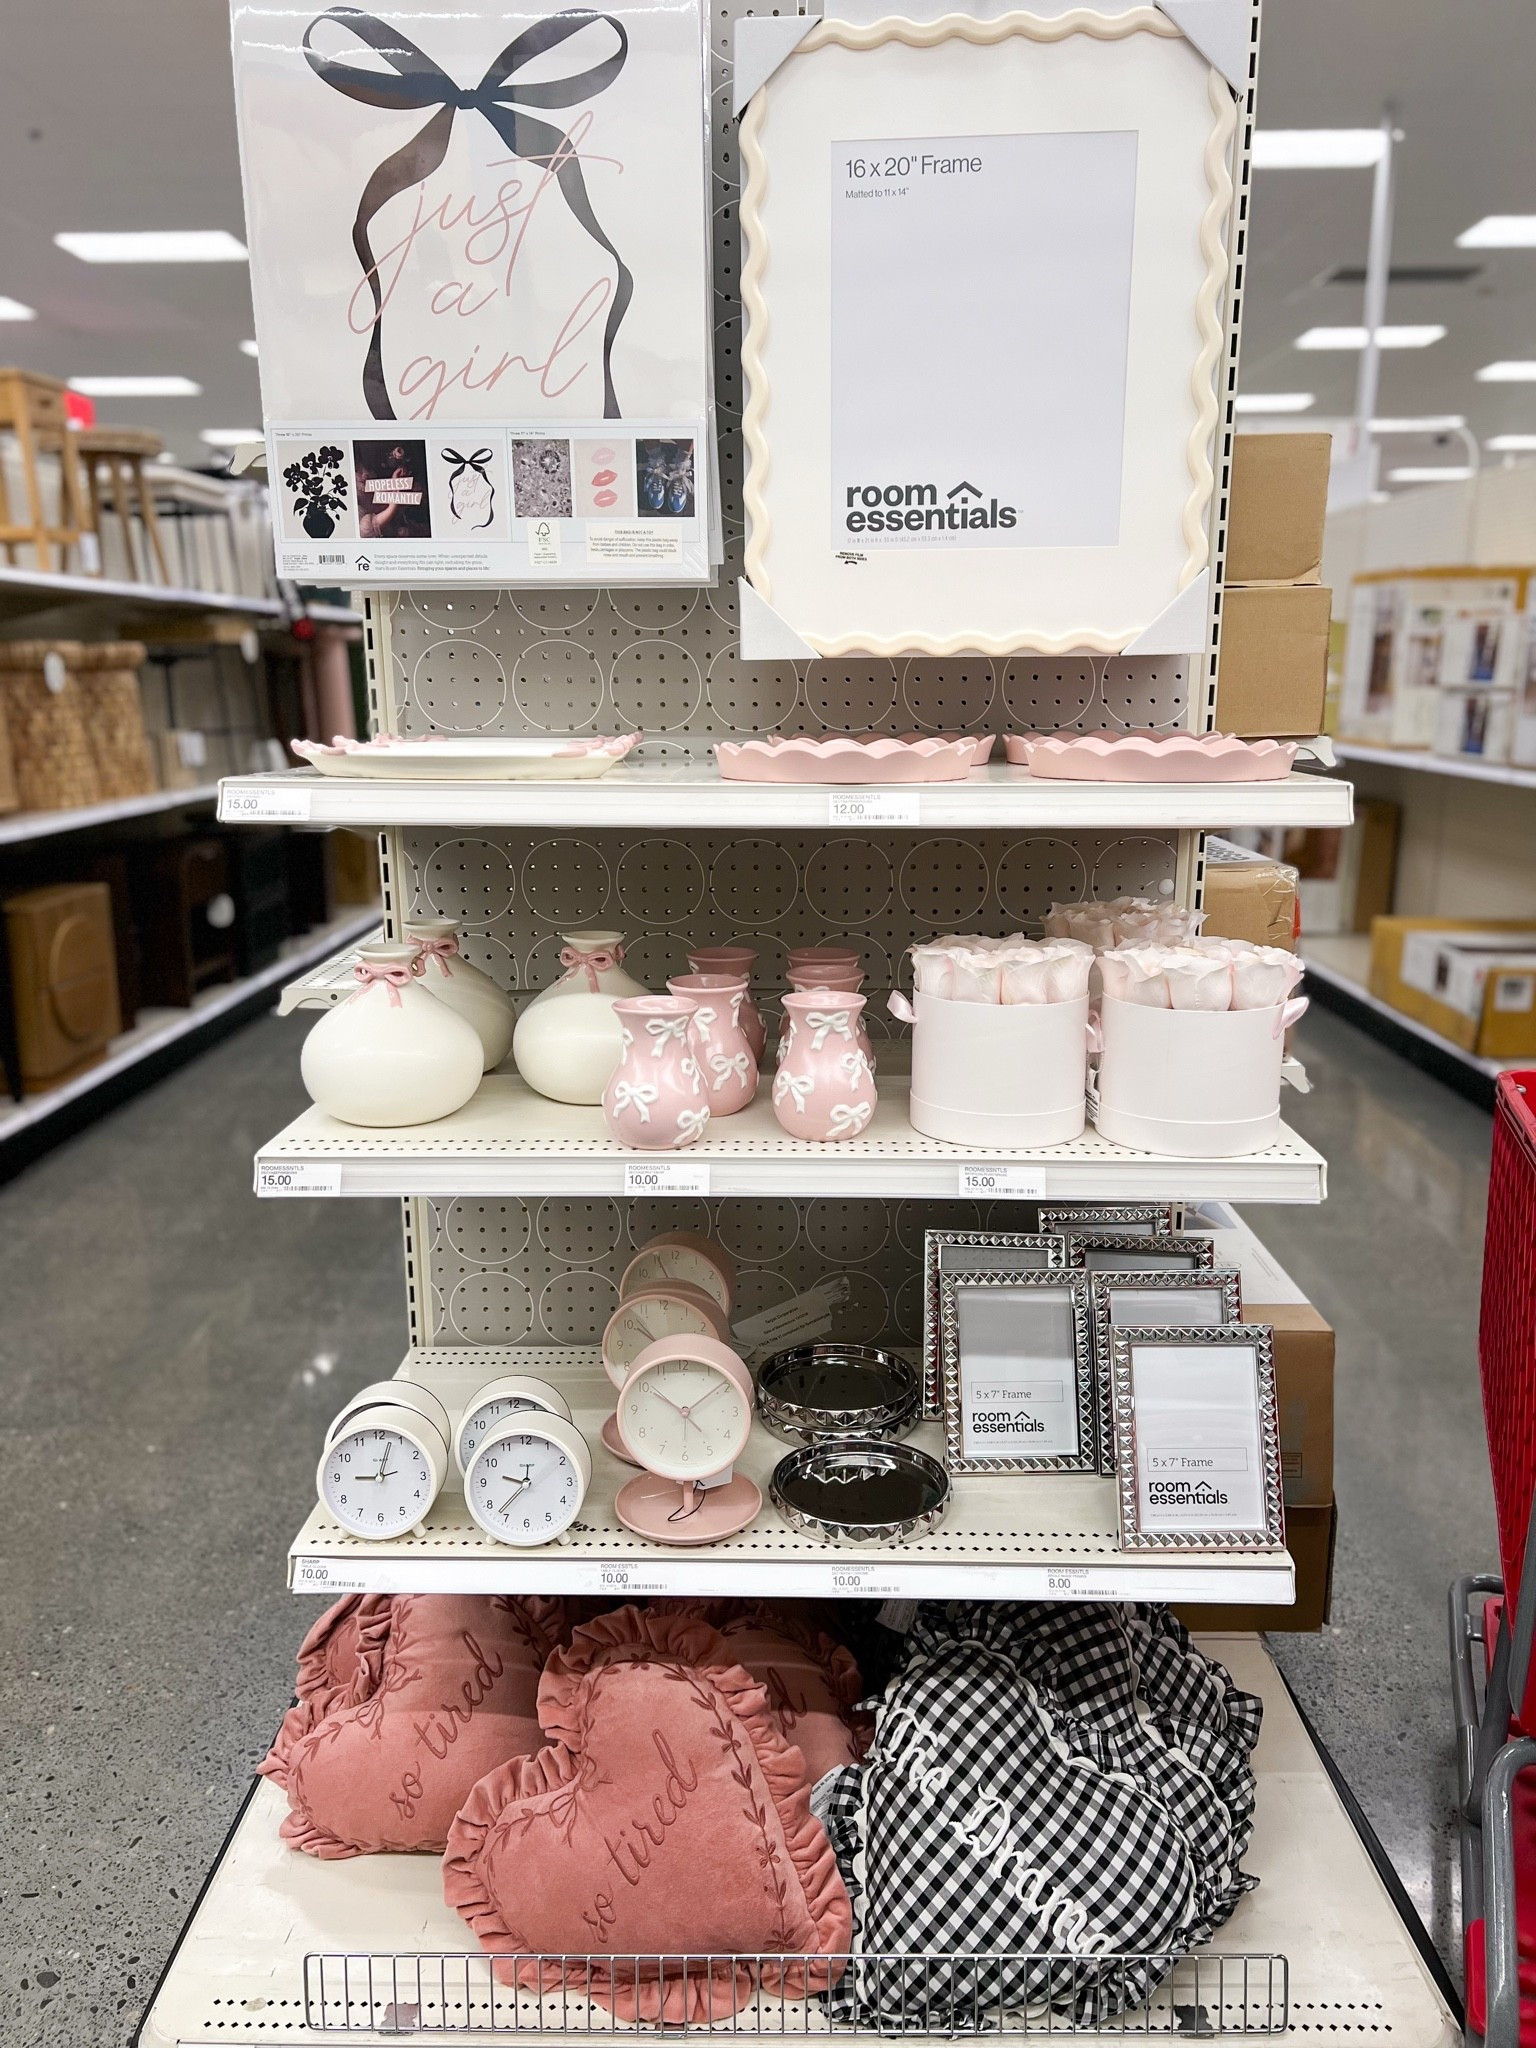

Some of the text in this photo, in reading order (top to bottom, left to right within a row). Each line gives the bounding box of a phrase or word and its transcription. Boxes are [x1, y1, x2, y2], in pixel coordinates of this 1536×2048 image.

[846, 155, 982, 179] 16 x 20" Frame
[845, 189, 874, 199] Matted
[874, 190, 883, 198] to
[884, 189, 891, 197] 11
[898, 187, 910, 197] 14"
[347, 111, 624, 335] just
[431, 280, 498, 317] a
[399, 276, 612, 420] girl
[368, 478, 409, 491] HOPELESS
[376, 492, 421, 504] ROMANTIC
[846, 484, 937, 507] room
[846, 497, 1017, 532] essentials
[357, 561, 370, 571] re
[227, 798, 258, 810] 15.00
[833, 803, 865, 814] 12.00
[261, 1174, 292, 1186] 15.00
[629, 1174, 658, 1185] 10.00
[965, 1176, 995, 1187] 15.00
[671, 1250, 680, 1260] 12
[659, 1300, 668, 1311] 12
[623, 1319, 634, 1330] 10
[616, 1339, 624, 1350] 9
[678, 1359, 689, 1371] 12
[638, 1381, 650, 1393] 10
[976, 1390, 982, 1399] 5
[1002, 1390, 1032, 1399] Frame
[508, 1400, 520, 1409] 12
[630, 1404, 638, 1415] 9
[490, 1406, 500, 1415] 11
[732, 1406, 739, 1417] 3
[972, 1412, 1011, 1422] room
[474, 1420, 486, 1430] 10
[972, 1418, 1045, 1433] essentials
[373, 1431, 386, 1440] 12
[638, 1427, 646, 1438] 8
[723, 1429, 731, 1440] 4
[354, 1438, 365, 1447] 11
[398, 1436, 403, 1445] 1
[468, 1440, 475, 1449] 9
[519, 1435, 532, 1445] 12
[500, 1443, 511, 1452] 11
[545, 1442, 550, 1451] 1
[658, 1444, 666, 1456] 7
[706, 1445, 714, 1457] 5
[338, 1453, 351, 1463] 10
[412, 1450, 420, 1460] 2
[681, 1451, 689, 1462] 6
[485, 1458, 498, 1468] 10
[559, 1456, 566, 1466] 2
[1152, 1457, 1159, 1467] 5
[1169, 1457, 1179, 1467] 7"
[1181, 1457, 1214, 1467] Frame
[333, 1473, 341, 1483] 9
[420, 1471, 427, 1481] 3
[480, 1478, 487, 1488] 9
[566, 1477, 573, 1487] 3
[1148, 1482, 1191, 1493] room
[340, 1494, 348, 1504] 8
[413, 1489, 421, 1498] 4
[1149, 1489, 1228, 1505] essentials
[486, 1500, 493, 1509] 8
[559, 1495, 567, 1505] 4
[357, 1508, 364, 1518] 7
[399, 1506, 406, 1516] 5
[377, 1512, 384, 1522] 6
[503, 1513, 510, 1523] 7
[545, 1512, 552, 1522] 5
[523, 1519, 530, 1528] 6
[301, 1568, 329, 1580] 10.00
[601, 1573, 629, 1583] 10.00
[832, 1575, 861, 1586] 10.00
[1048, 1578, 1071, 1589] 8.00
[390, 1631, 503, 1821] so tired
[581, 1729, 698, 1944] so tired
[864, 1707, 1114, 1955] The Drama
